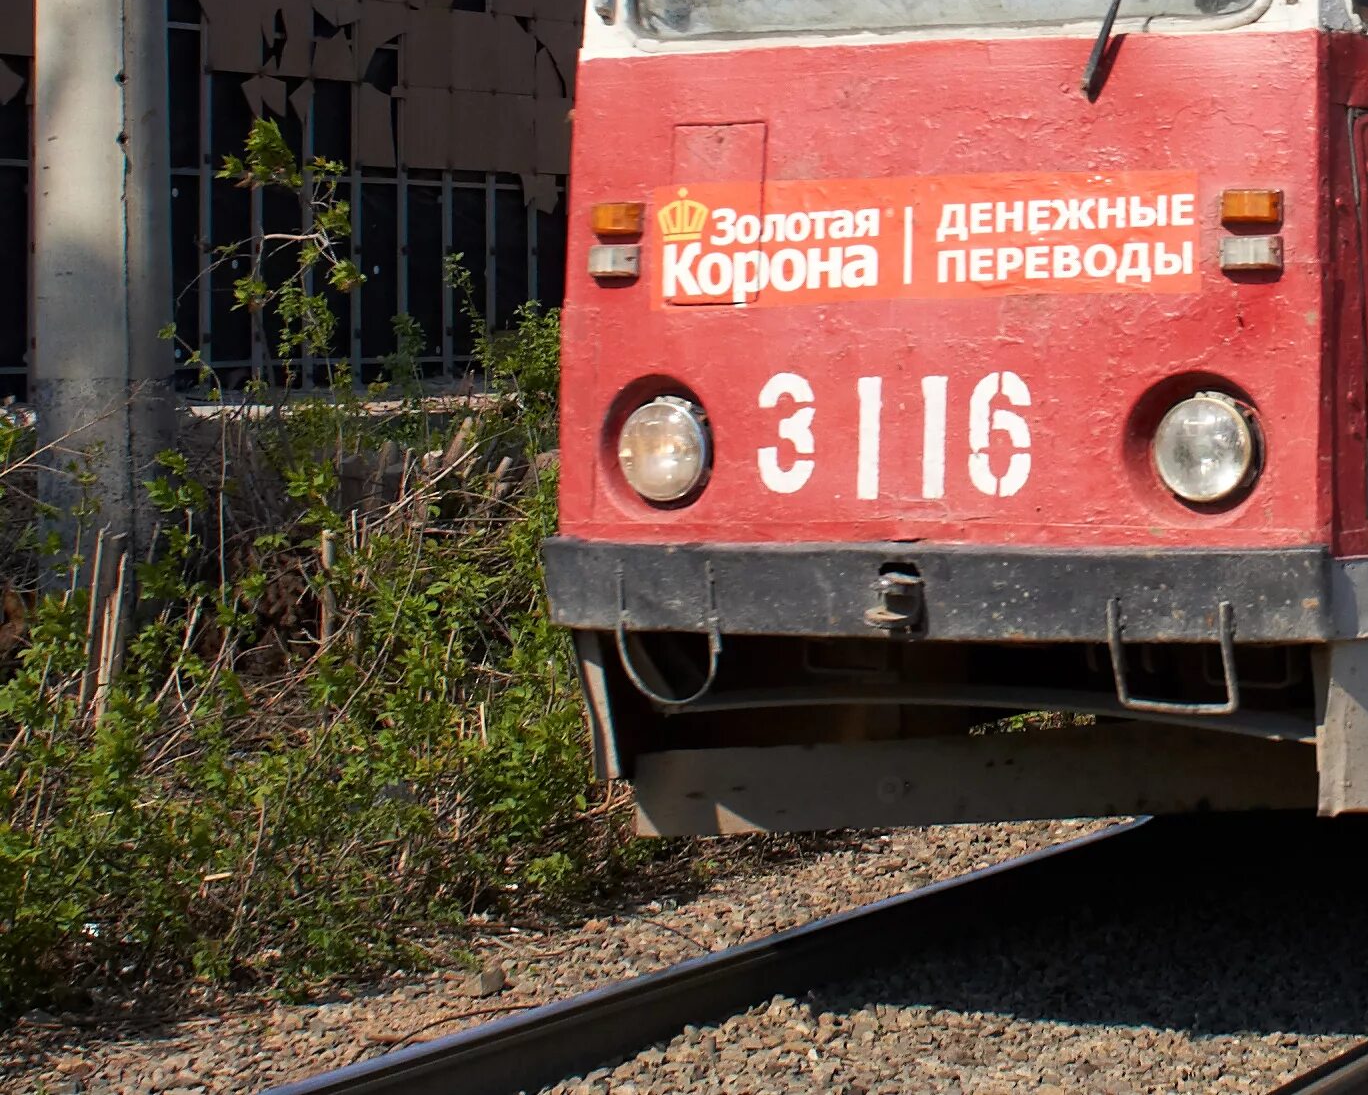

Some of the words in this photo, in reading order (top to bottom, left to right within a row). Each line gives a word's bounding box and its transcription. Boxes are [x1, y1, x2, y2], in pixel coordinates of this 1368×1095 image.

[710, 208, 880, 246] Золотая
[936, 193, 1195, 242] ДЕНЕЖНЫЕ
[662, 241, 878, 308] Корона
[937, 241, 1193, 283] ПЕРЕВОДЫ
[757, 371, 1031, 500] 3116
